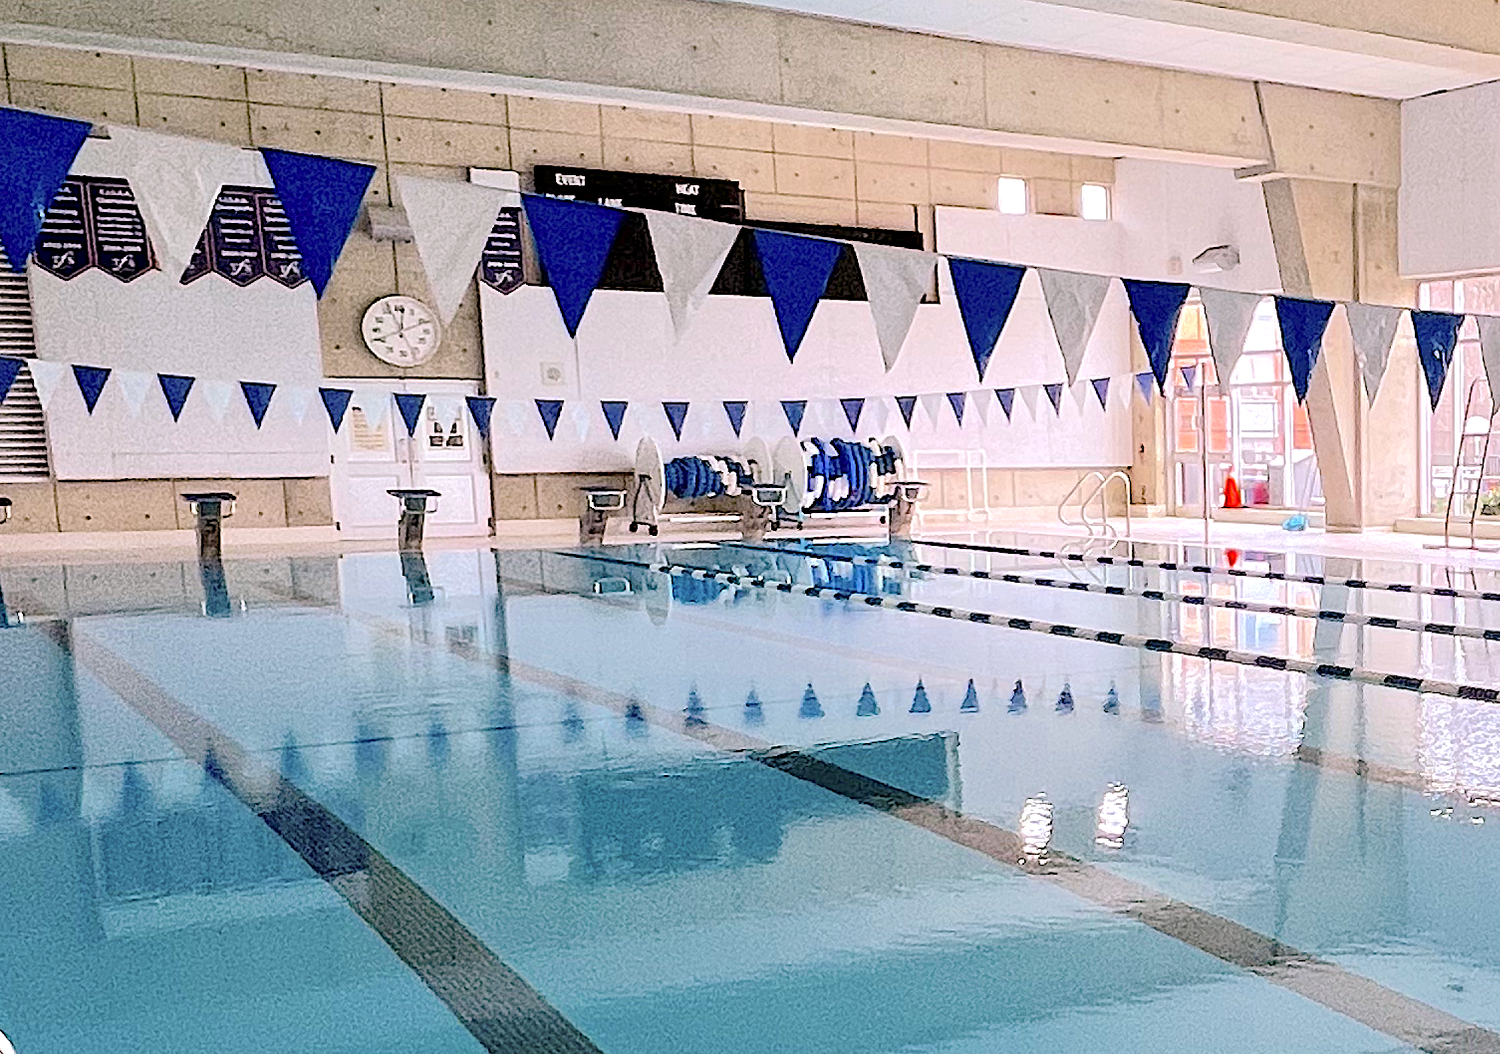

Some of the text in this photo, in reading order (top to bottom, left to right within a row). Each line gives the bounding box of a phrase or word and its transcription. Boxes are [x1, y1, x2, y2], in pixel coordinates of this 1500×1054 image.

[555, 173, 586, 186] EVENT
[675, 183, 700, 196] HEAT
[205, 518, 218, 533] 5
